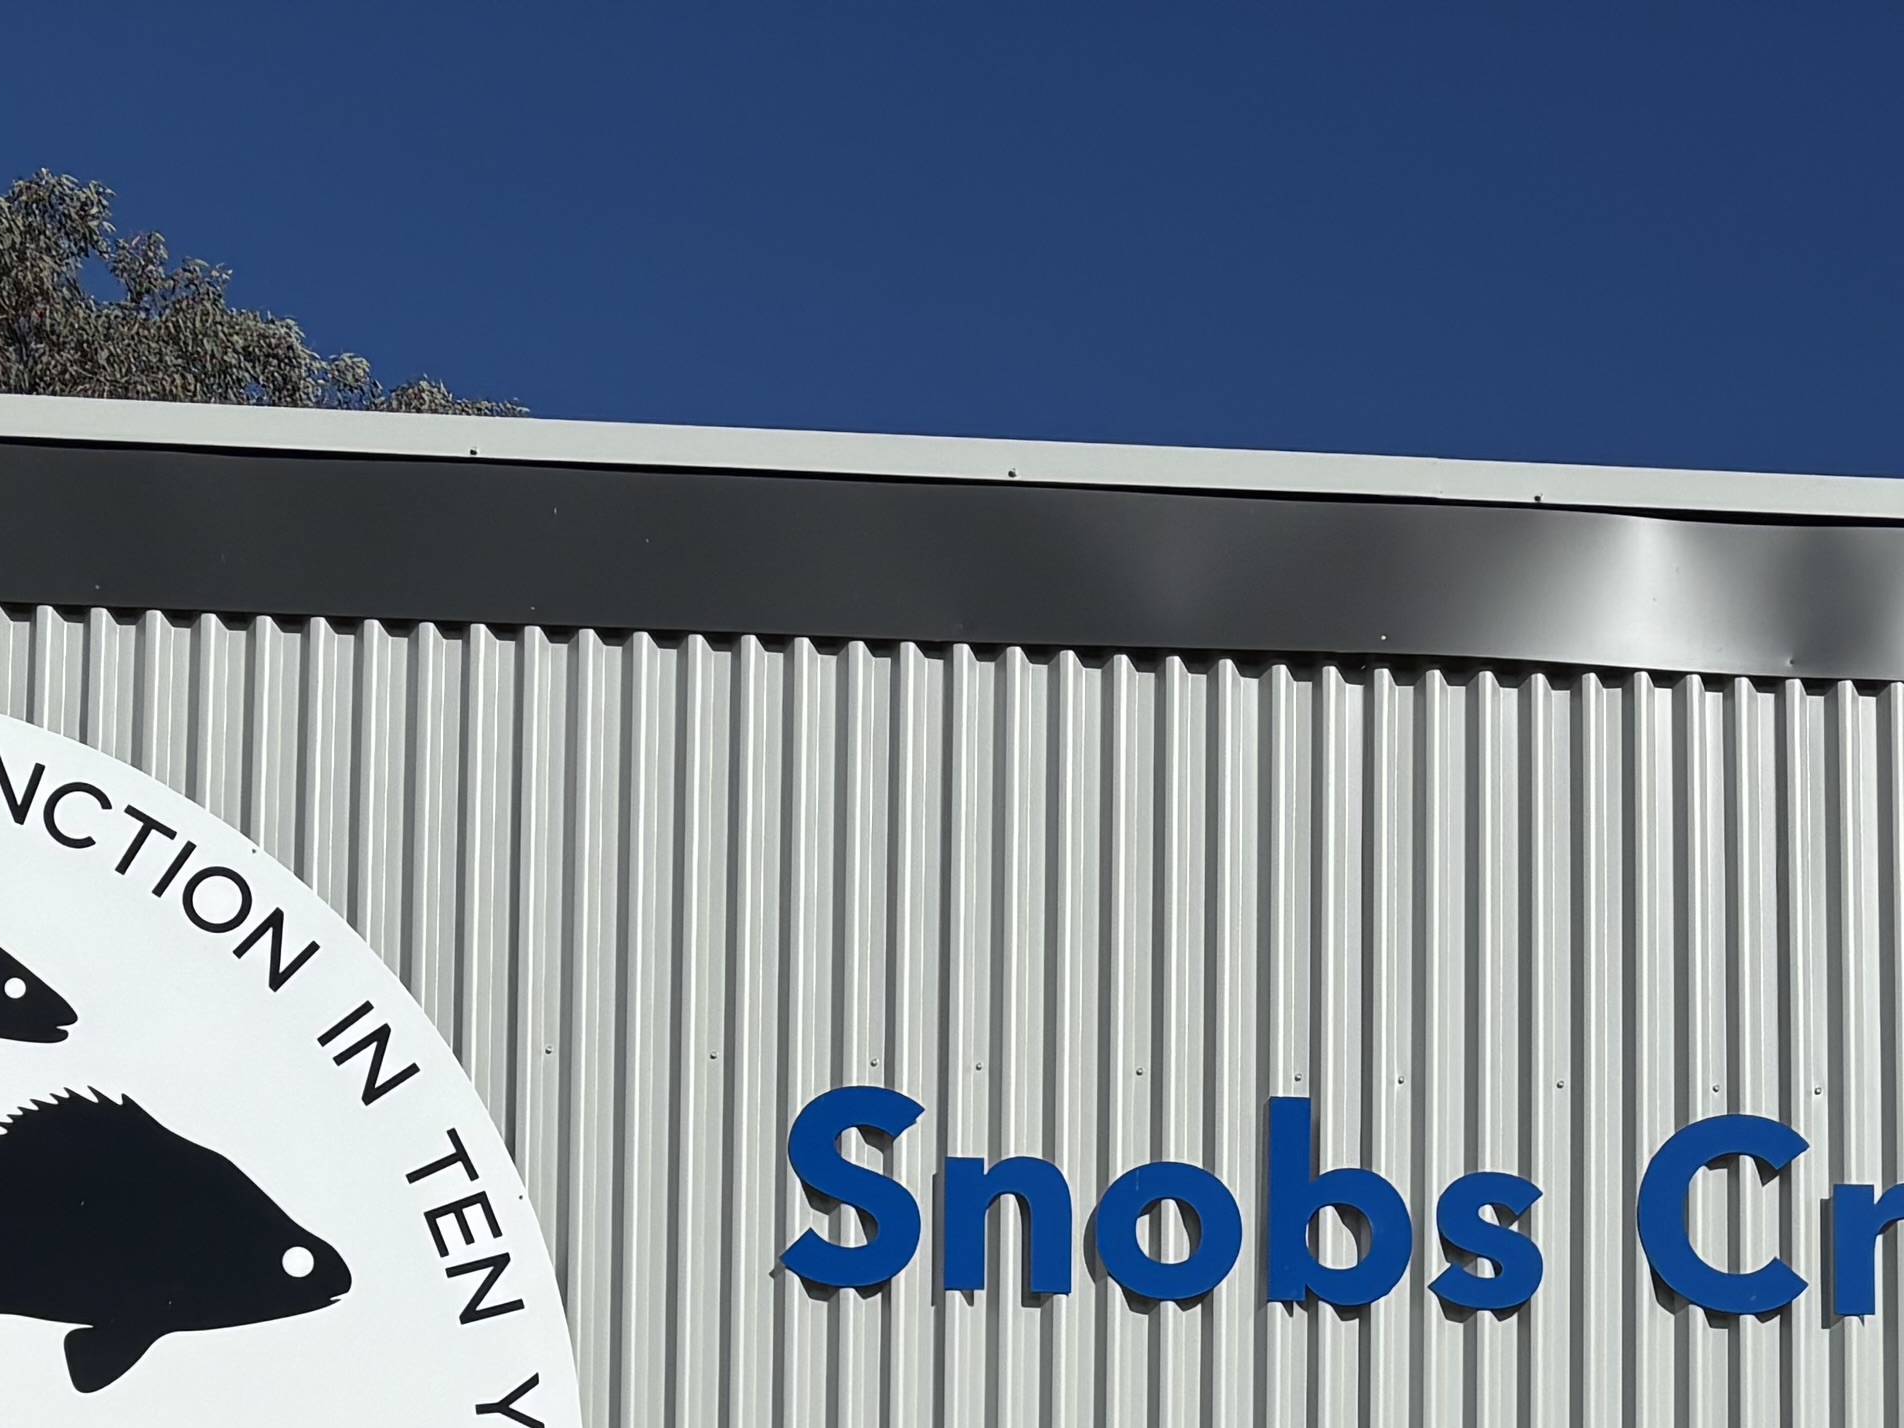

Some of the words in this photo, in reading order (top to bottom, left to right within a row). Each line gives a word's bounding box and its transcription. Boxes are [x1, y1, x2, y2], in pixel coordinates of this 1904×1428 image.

[316, 1000, 421, 1107] IN
[405, 1127, 525, 1325] TEN
[779, 1085, 1545, 1316] Snobs
